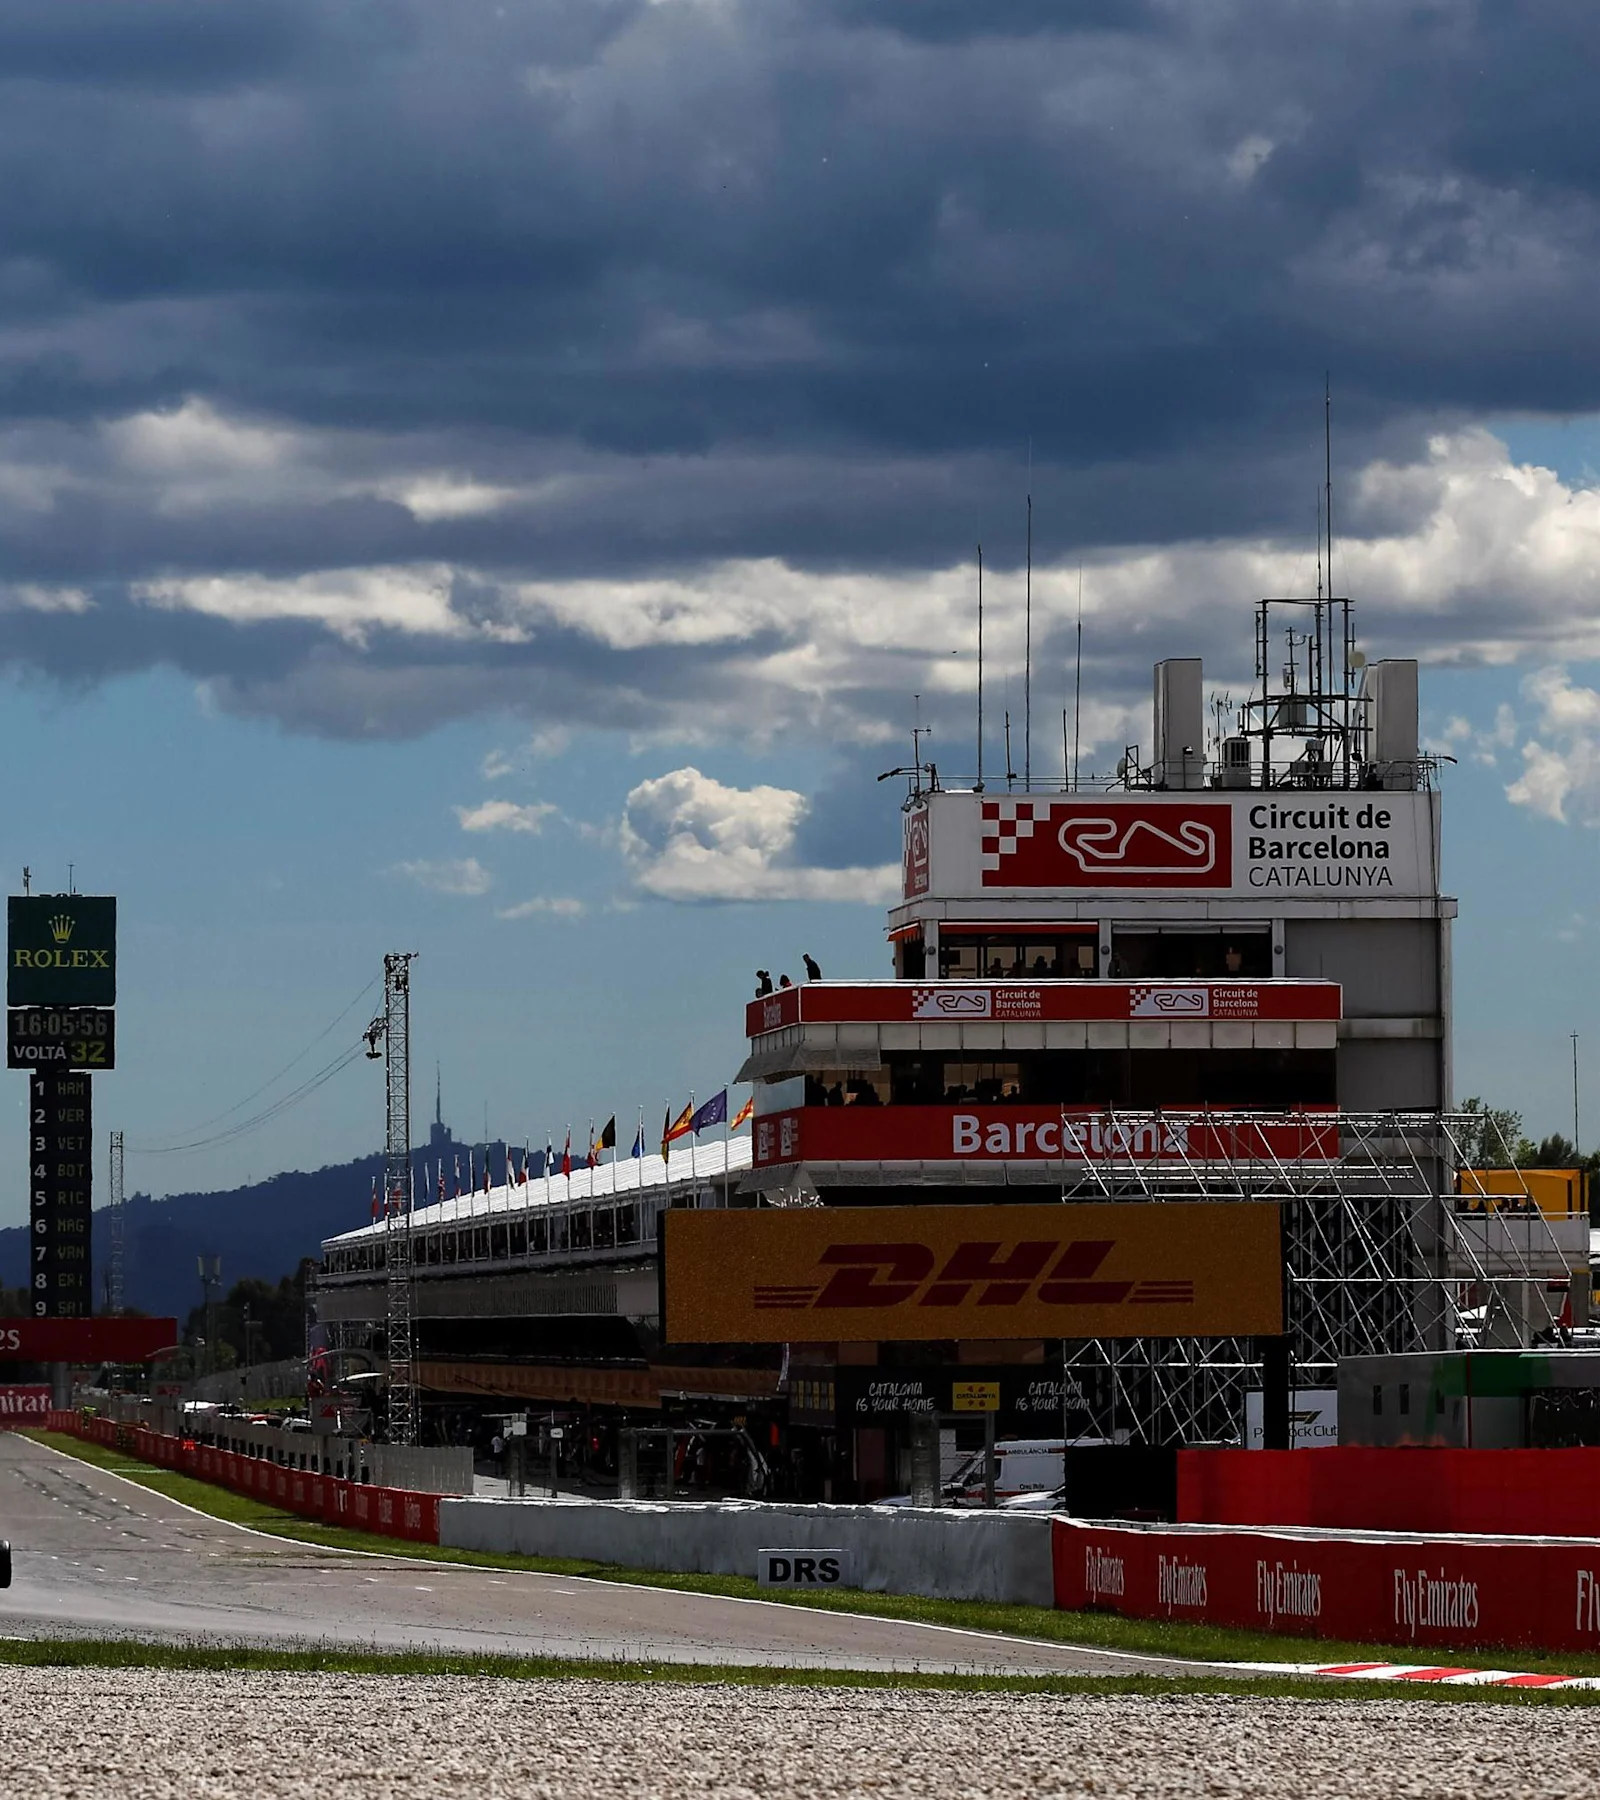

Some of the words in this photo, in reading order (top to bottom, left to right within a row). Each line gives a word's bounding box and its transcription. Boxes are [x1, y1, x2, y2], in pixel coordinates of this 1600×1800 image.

[1249, 803, 1349, 829] Circuit
[1356, 803, 1391, 829] de
[1249, 835, 1388, 859] Barcelona
[1248, 866, 1393, 886] CATALUNYA
[13, 949, 110, 968] ROLEX
[995, 989, 1027, 999] Circuit
[1028, 989, 1041, 999] de
[1212, 988, 1245, 998] Circuit
[1246, 988, 1258, 998] de
[996, 999, 1041, 1009] Barcelona
[1213, 998, 1258, 1008] Barcelona
[995, 1010, 1041, 1018] CATALUNYA
[1213, 1009, 1258, 1017] CATALUNYA
[13, 1013, 108, 1036] 16:05:56
[71, 1040, 107, 1063] 32
[35, 1081, 47, 1096] 1
[35, 1108, 47, 1124] 2
[57, 1109, 84, 1123] VER
[953, 1114, 1188, 1153] Barcelona
[35, 1136, 47, 1152] 3
[57, 1136, 84, 1151] VET
[35, 1163, 47, 1179] 4
[35, 1191, 47, 1206] 5
[57, 1191, 84, 1205] RIC
[35, 1218, 47, 1234] 6
[35, 1246, 47, 1261] 7
[35, 1273, 47, 1289] 8
[811, 1240, 1135, 1308] DHL
[35, 1301, 47, 1316] 9
[872, 1396, 900, 1414] YOUR
[902, 1397, 936, 1412] HOME
[1032, 1396, 1060, 1411] YOUR
[1253, 1426, 1312, 1438] Pock
[768, 1557, 840, 1583] DRS
[1158, 1554, 1172, 1616] Fly
[1173, 1554, 1207, 1607] Emirates
[1257, 1560, 1275, 1625] Fly
[1276, 1559, 1321, 1617] Emirates
[1394, 1568, 1415, 1639] Fly
[1418, 1567, 1479, 1628] Emirates
[1576, 1570, 1600, 1632] Fl
